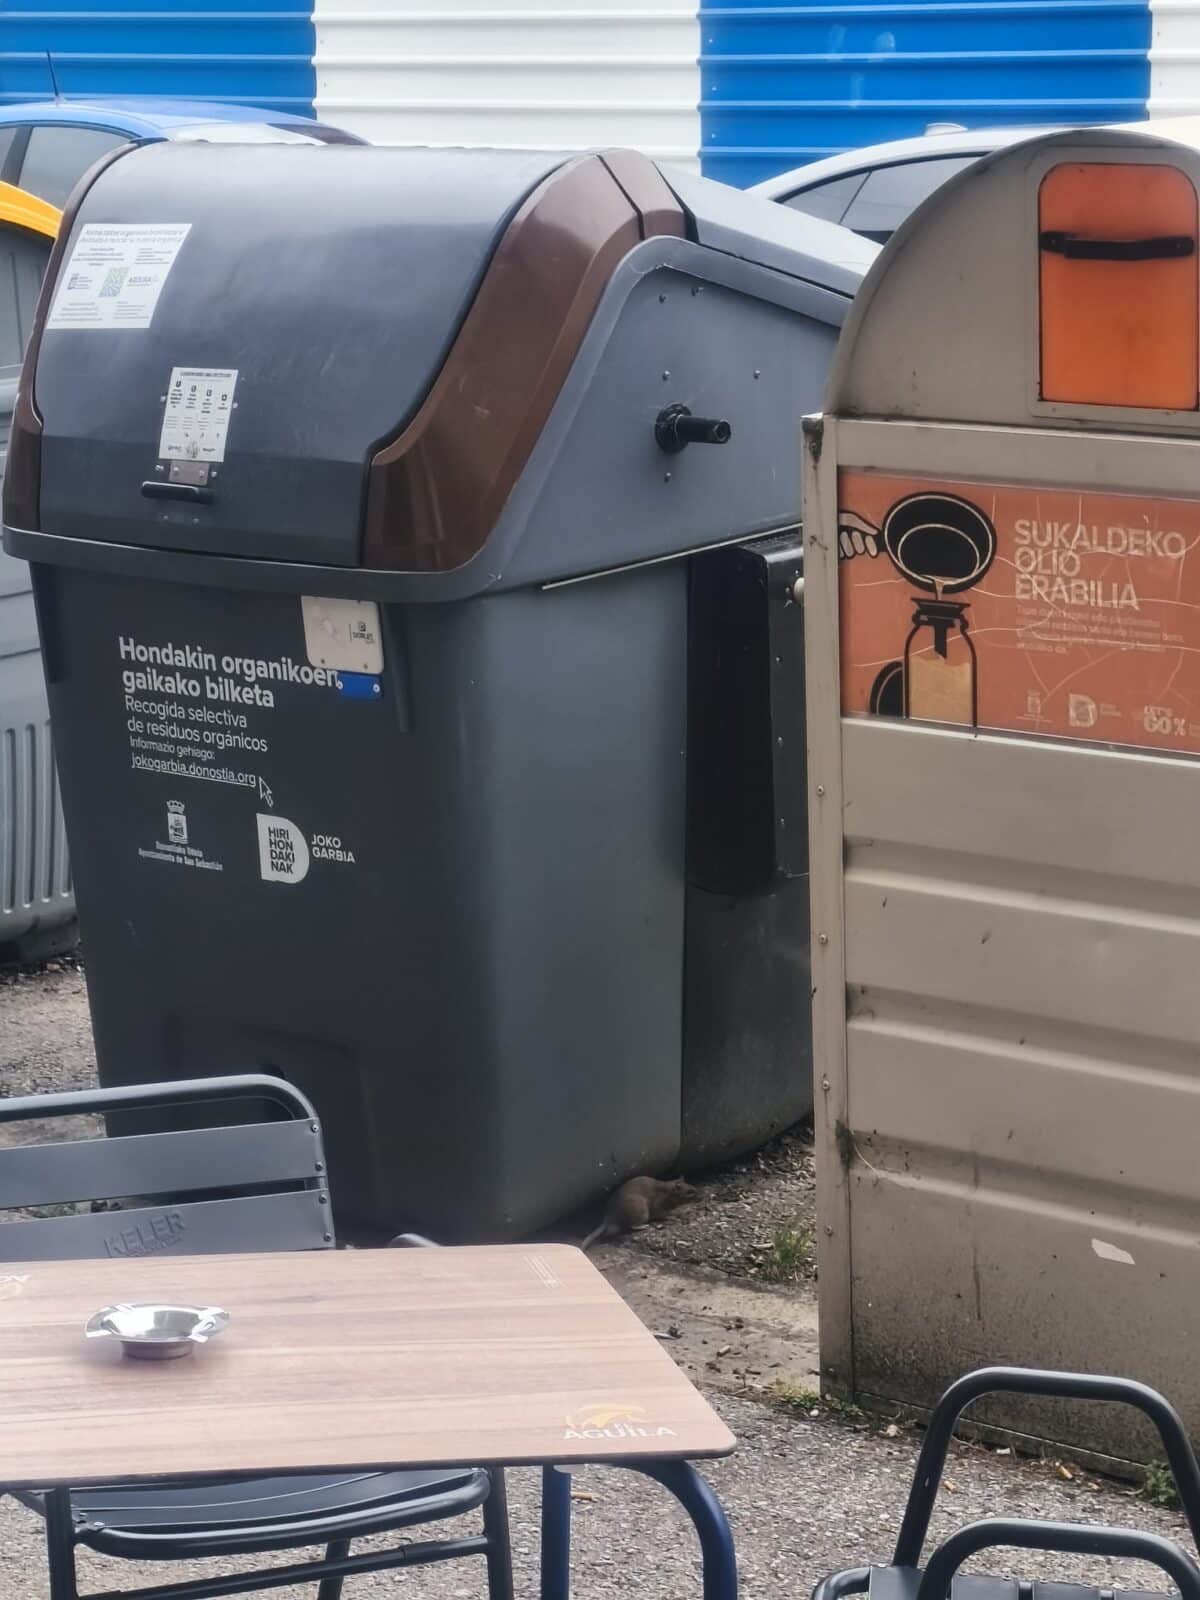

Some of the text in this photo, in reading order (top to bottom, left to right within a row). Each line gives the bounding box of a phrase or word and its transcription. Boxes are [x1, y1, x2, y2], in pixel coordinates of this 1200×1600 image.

[1014, 519, 1187, 559] SUKALDEKO
[1015, 547, 1081, 576] OLIO
[1015, 574, 1140, 610] ERABILIA
[118, 635, 339, 688] Hondakin organikoen
[122, 667, 275, 708] gaikako bilketa
[125, 695, 248, 728] Recogida selectiva
[127, 716, 268, 752] de residuos orgánicos
[130, 736, 216, 761] Informazio gehiago:
[131, 753, 256, 787] jokogarbia.donostia.org
[268, 826, 290, 841] HIRI
[268, 838, 294, 851] HON
[311, 834, 341, 849] JOKO
[270, 850, 296, 863] DAKI
[271, 860, 294, 874] NAK
[312, 847, 355, 863] GARBIA
[104, 1209, 185, 1258] KELER
